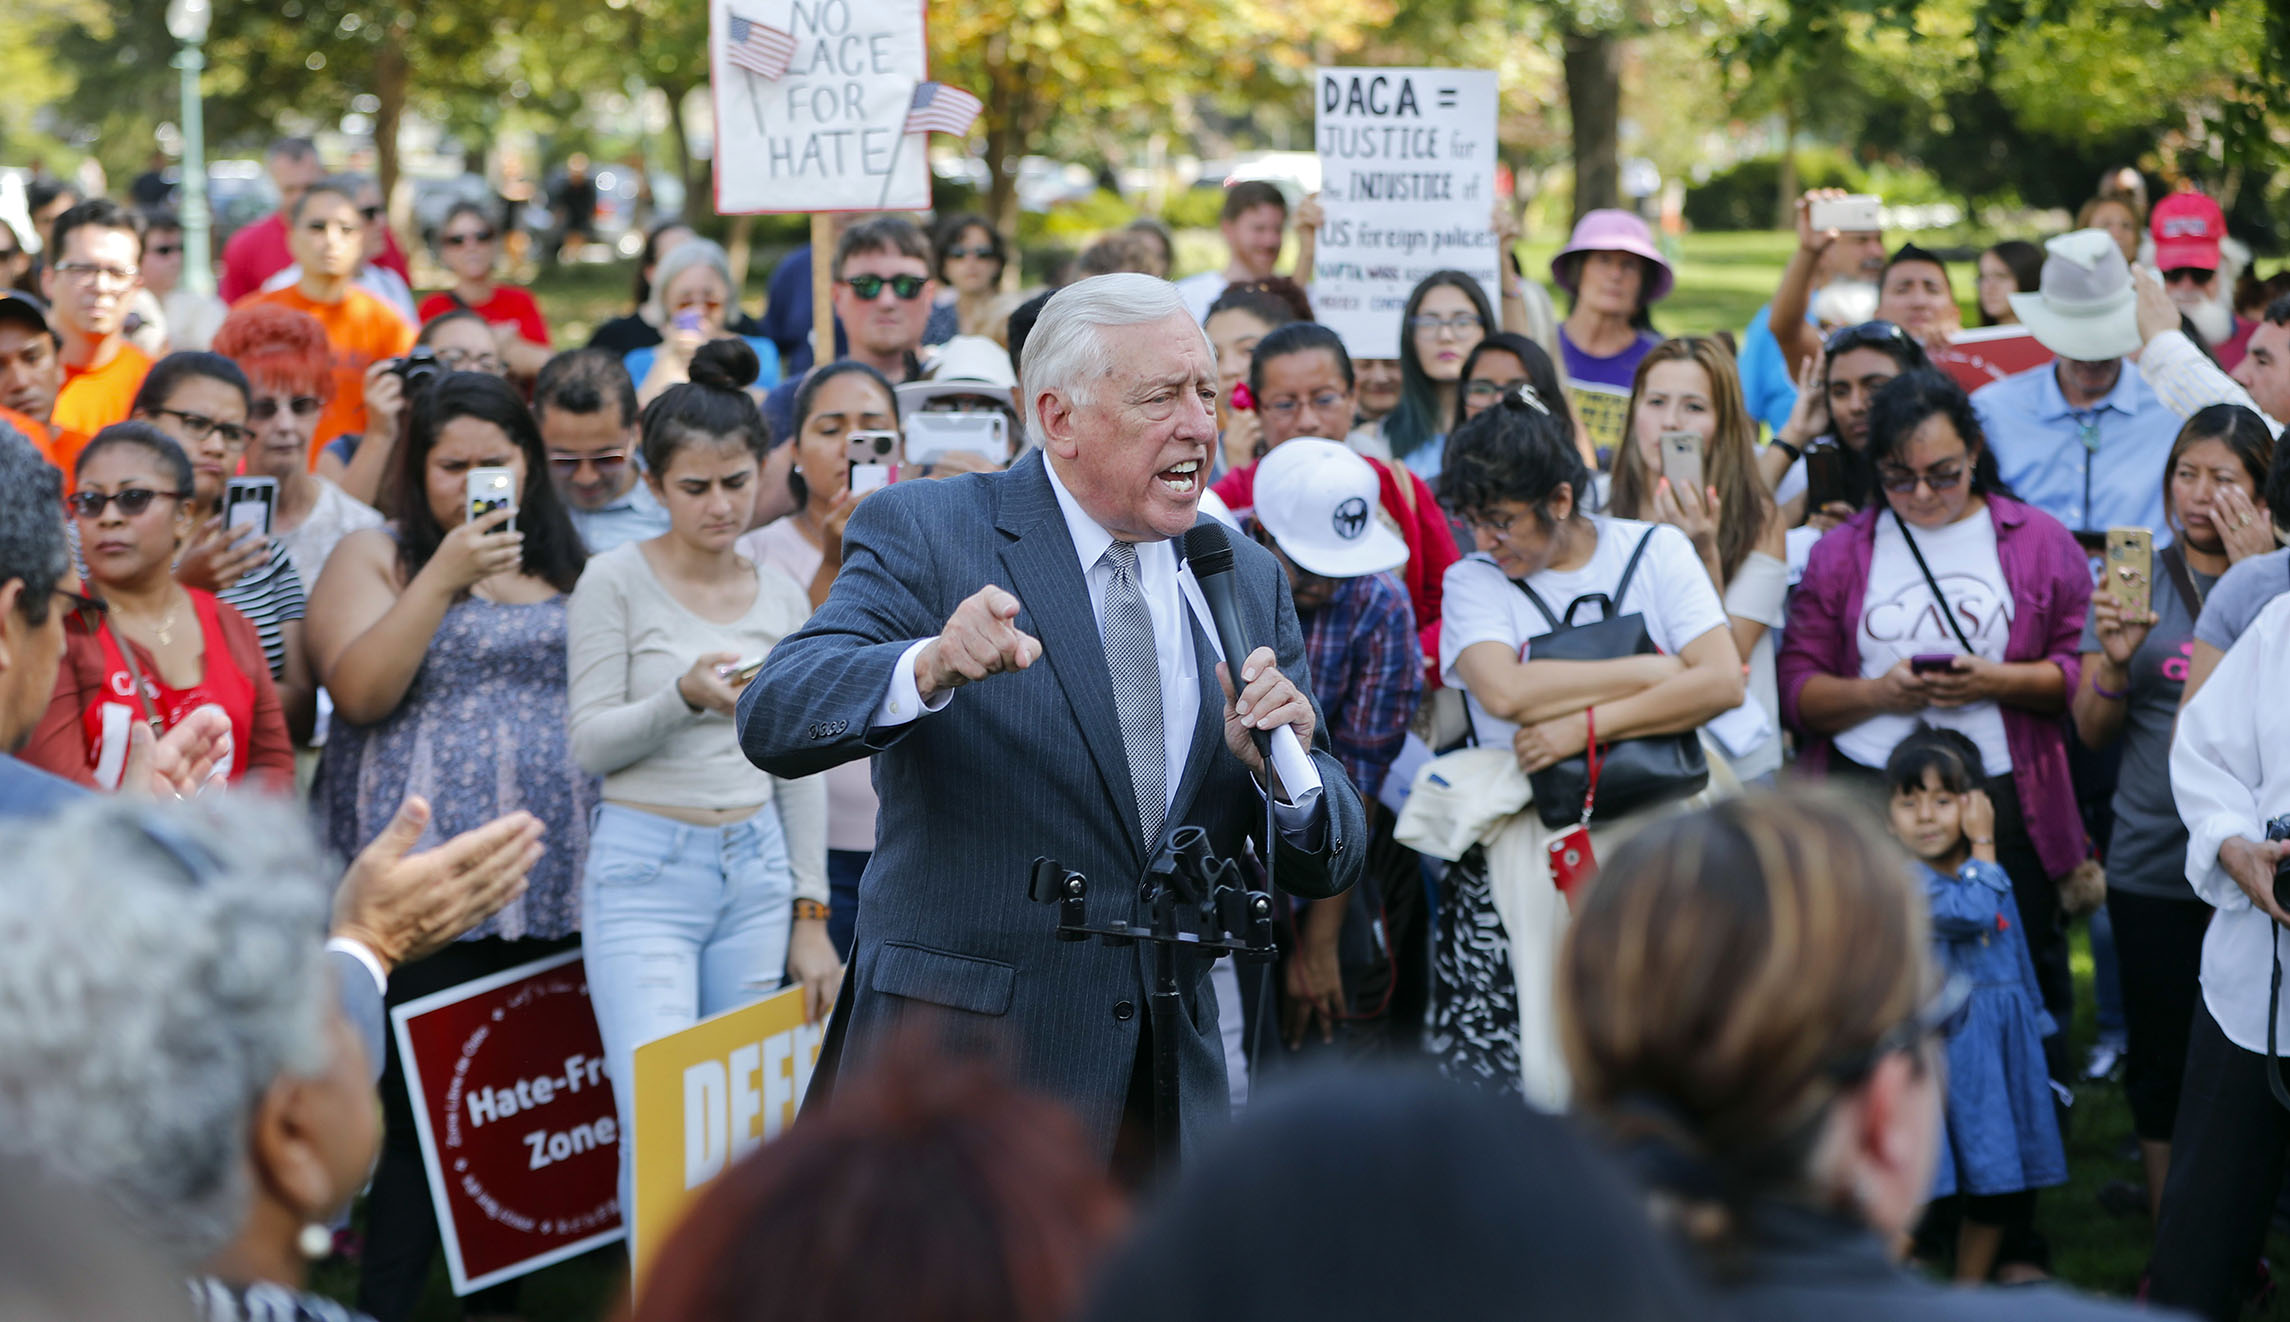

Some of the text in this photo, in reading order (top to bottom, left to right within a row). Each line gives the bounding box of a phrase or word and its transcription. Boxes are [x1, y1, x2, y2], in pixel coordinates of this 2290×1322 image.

[790, 0, 851, 36] NO
[787, 82, 867, 124] FOR
[1323, 76, 1420, 116] DACA
[768, 128, 893, 179] HATE
[1319, 126, 1475, 159] JUSTICE for
[1350, 172, 1452, 201] INJUSTICE
[1320, 219, 1352, 247] US
[1357, 221, 1428, 254] foreign
[1865, 597, 2010, 642] CASA
[522, 1116, 617, 1170] Zone
